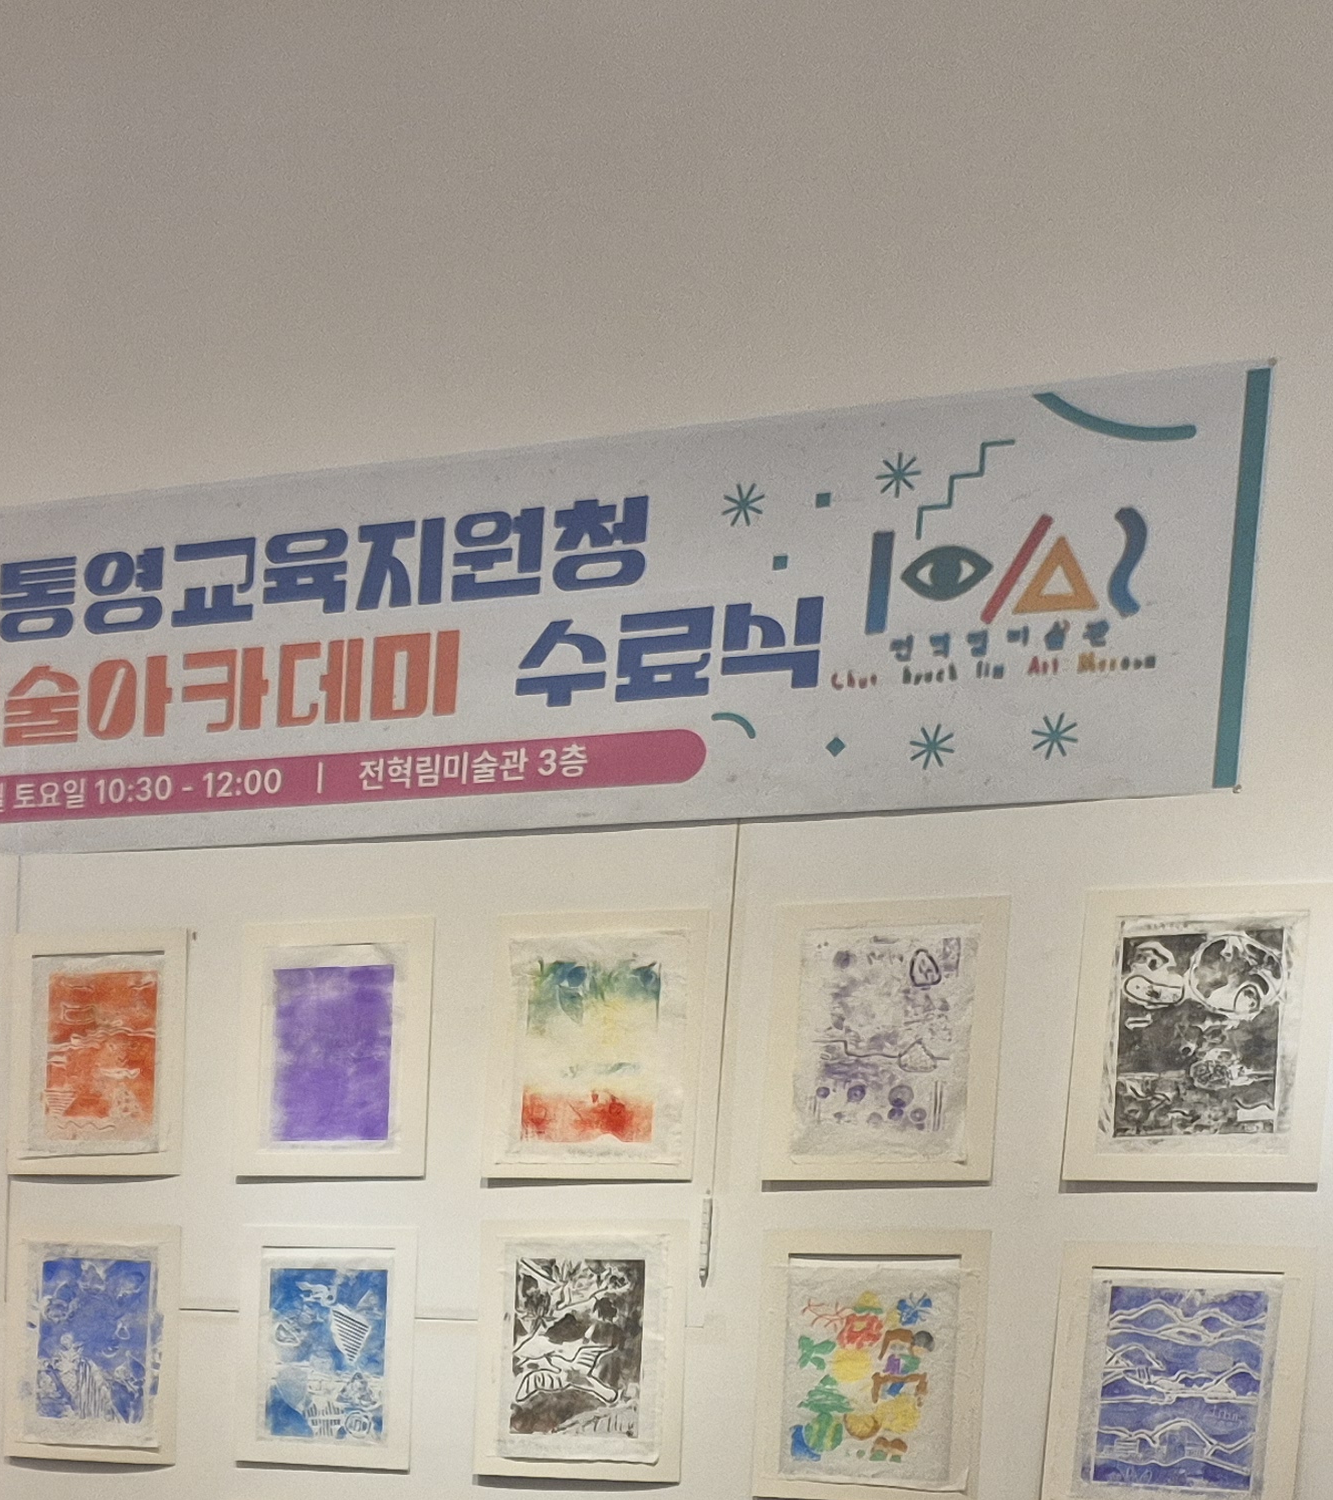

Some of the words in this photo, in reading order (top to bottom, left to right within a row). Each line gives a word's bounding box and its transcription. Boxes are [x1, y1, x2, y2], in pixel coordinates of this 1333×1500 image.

[514, 597, 825, 709] 수료식
[12, 777, 86, 810] 토요일
[94, 775, 173, 804] 10:30
[201, 769, 284, 799] 12:00
[358, 748, 529, 791] 전혁림미술관
[538, 744, 590, 777] 3층
